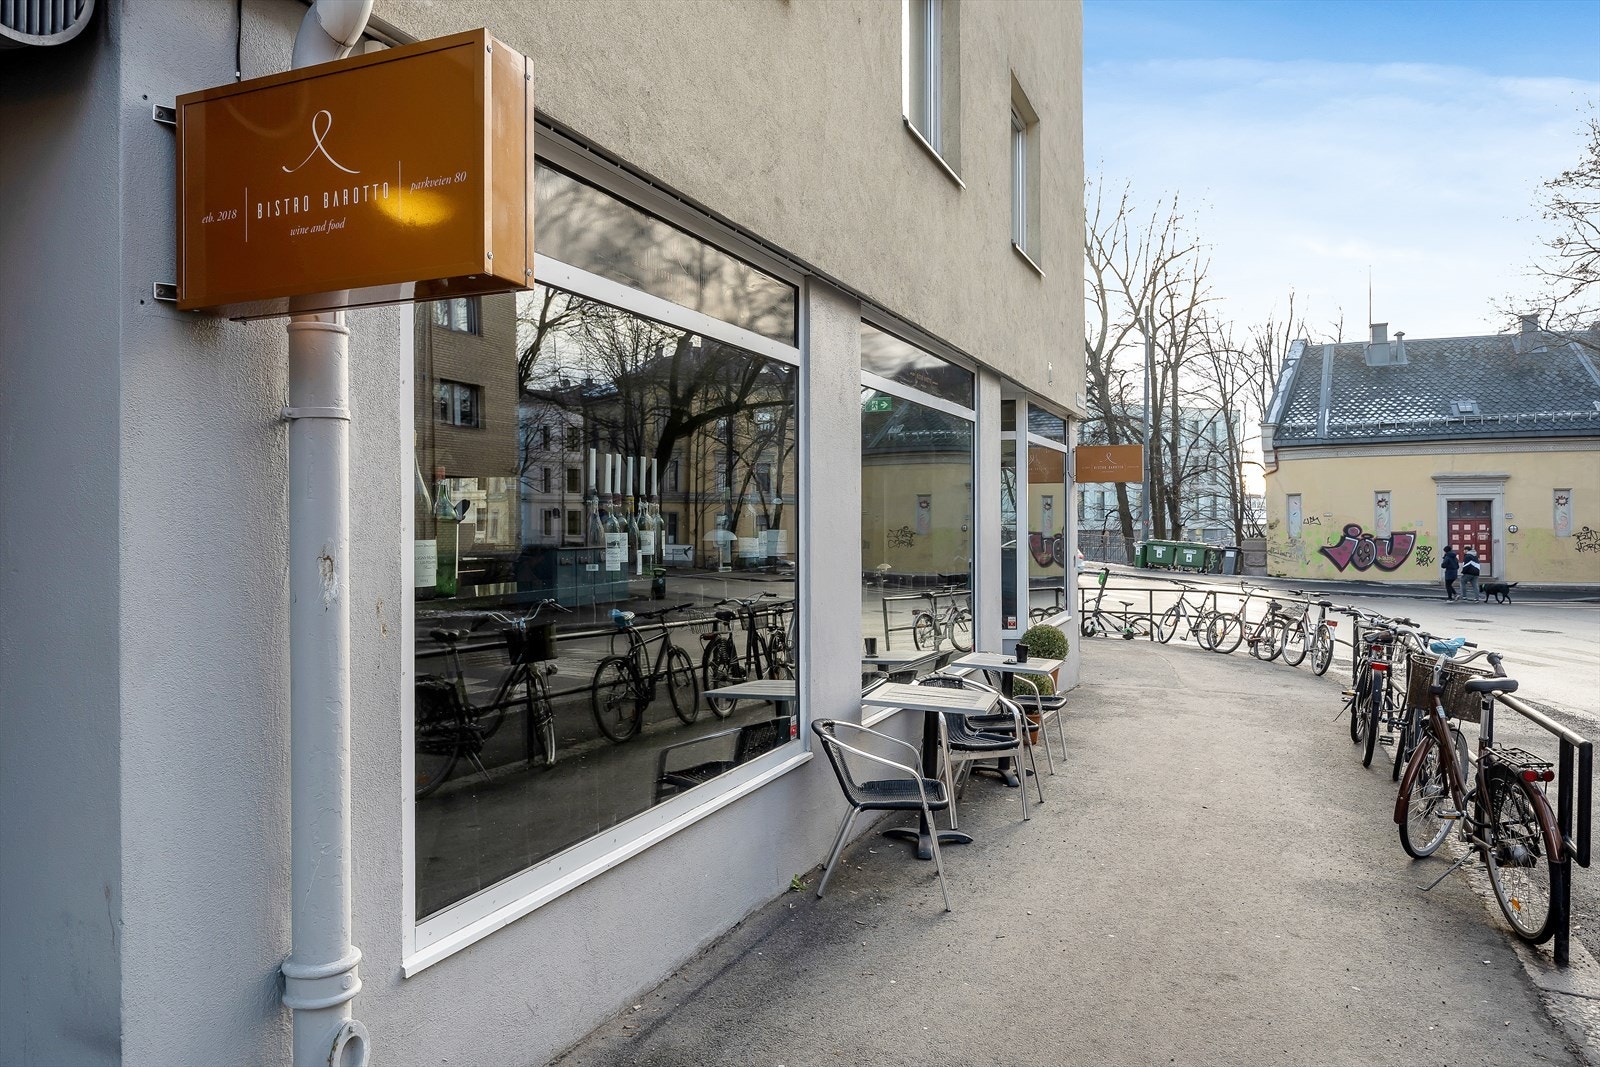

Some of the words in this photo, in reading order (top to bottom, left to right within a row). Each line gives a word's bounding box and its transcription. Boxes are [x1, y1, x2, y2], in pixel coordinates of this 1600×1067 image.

[409, 175, 451, 194] parkveien
[454, 171, 467, 183] 80
[257, 195, 309, 219] BISTRO
[323, 182, 389, 209] BAROTTO
[217, 209, 238, 222] 2018
[290, 225, 309, 236] wine
[310, 220, 326, 233] and
[326, 217, 347, 234] food
